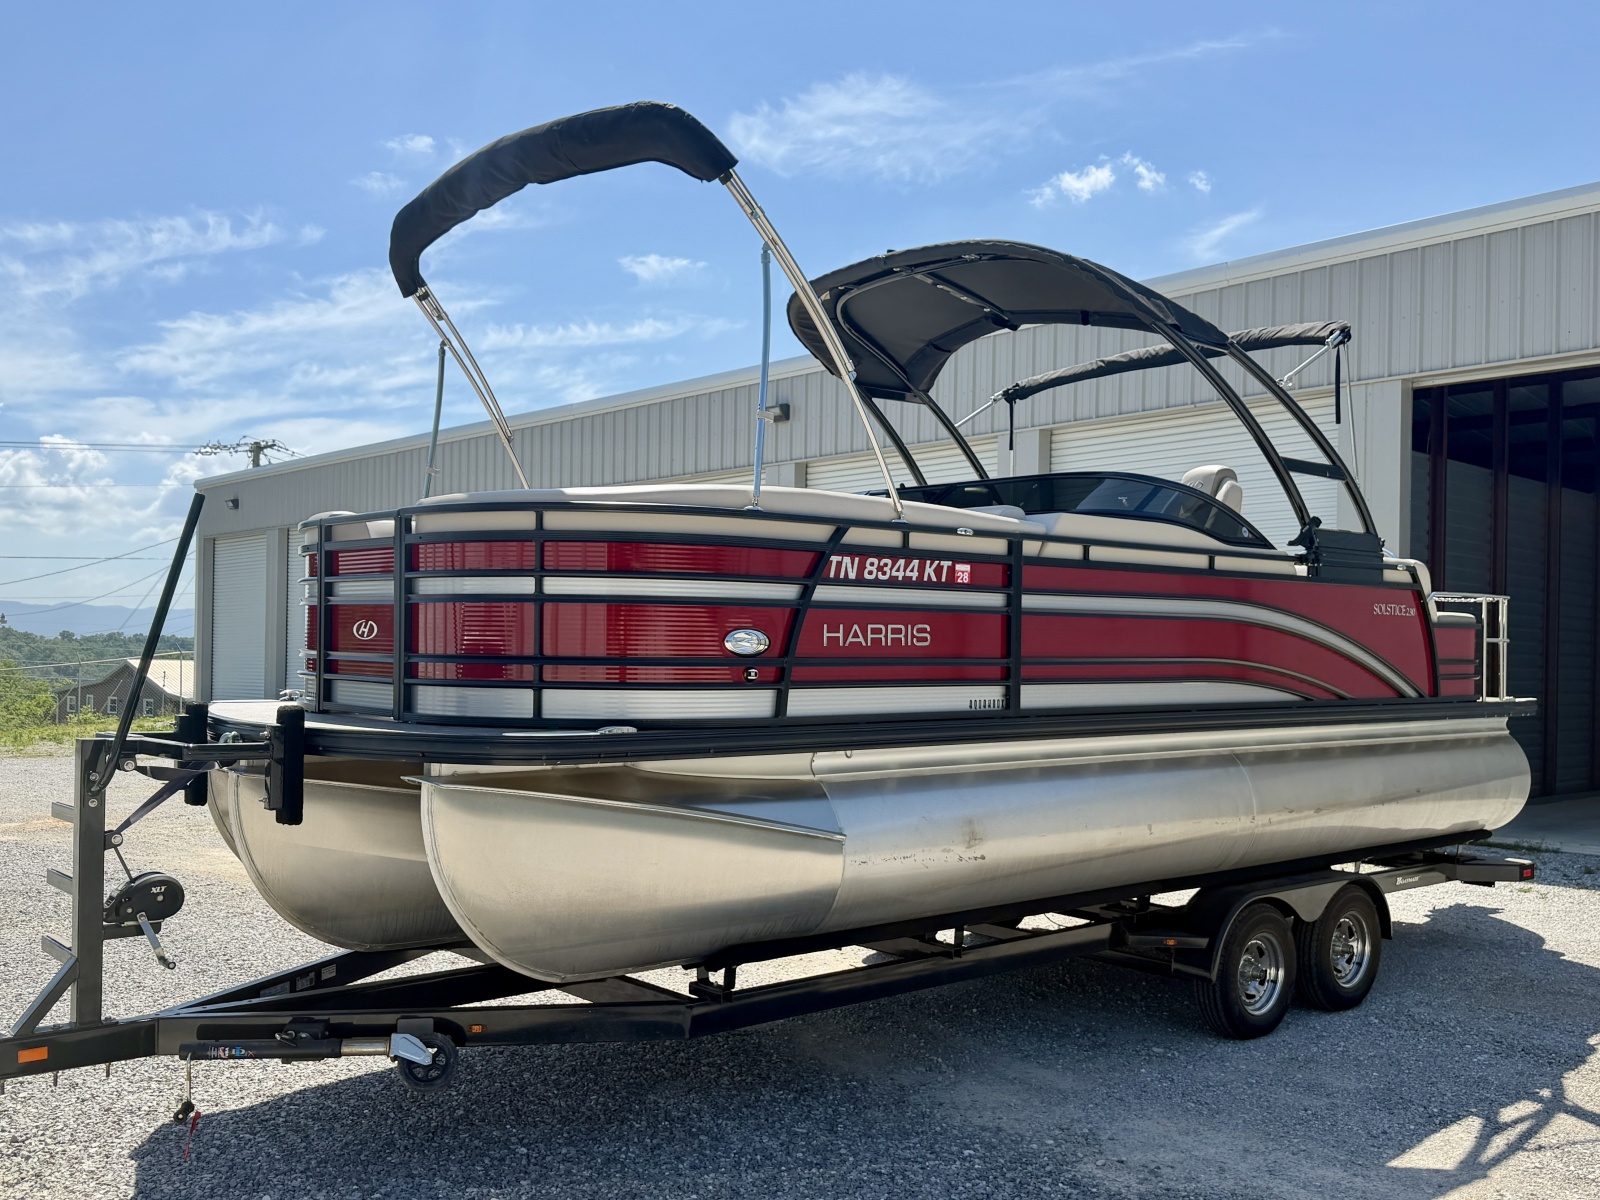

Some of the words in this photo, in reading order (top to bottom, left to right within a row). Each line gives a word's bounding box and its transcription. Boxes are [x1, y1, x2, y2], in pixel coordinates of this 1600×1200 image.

[829, 555, 859, 580] TN
[863, 557, 920, 582] 8344
[923, 560, 953, 583] KT
[957, 571, 969, 584] 28
[1373, 603, 1406, 616] SOLSTICE
[823, 623, 932, 647] HARRIS
[150, 885, 167, 893] XLT
